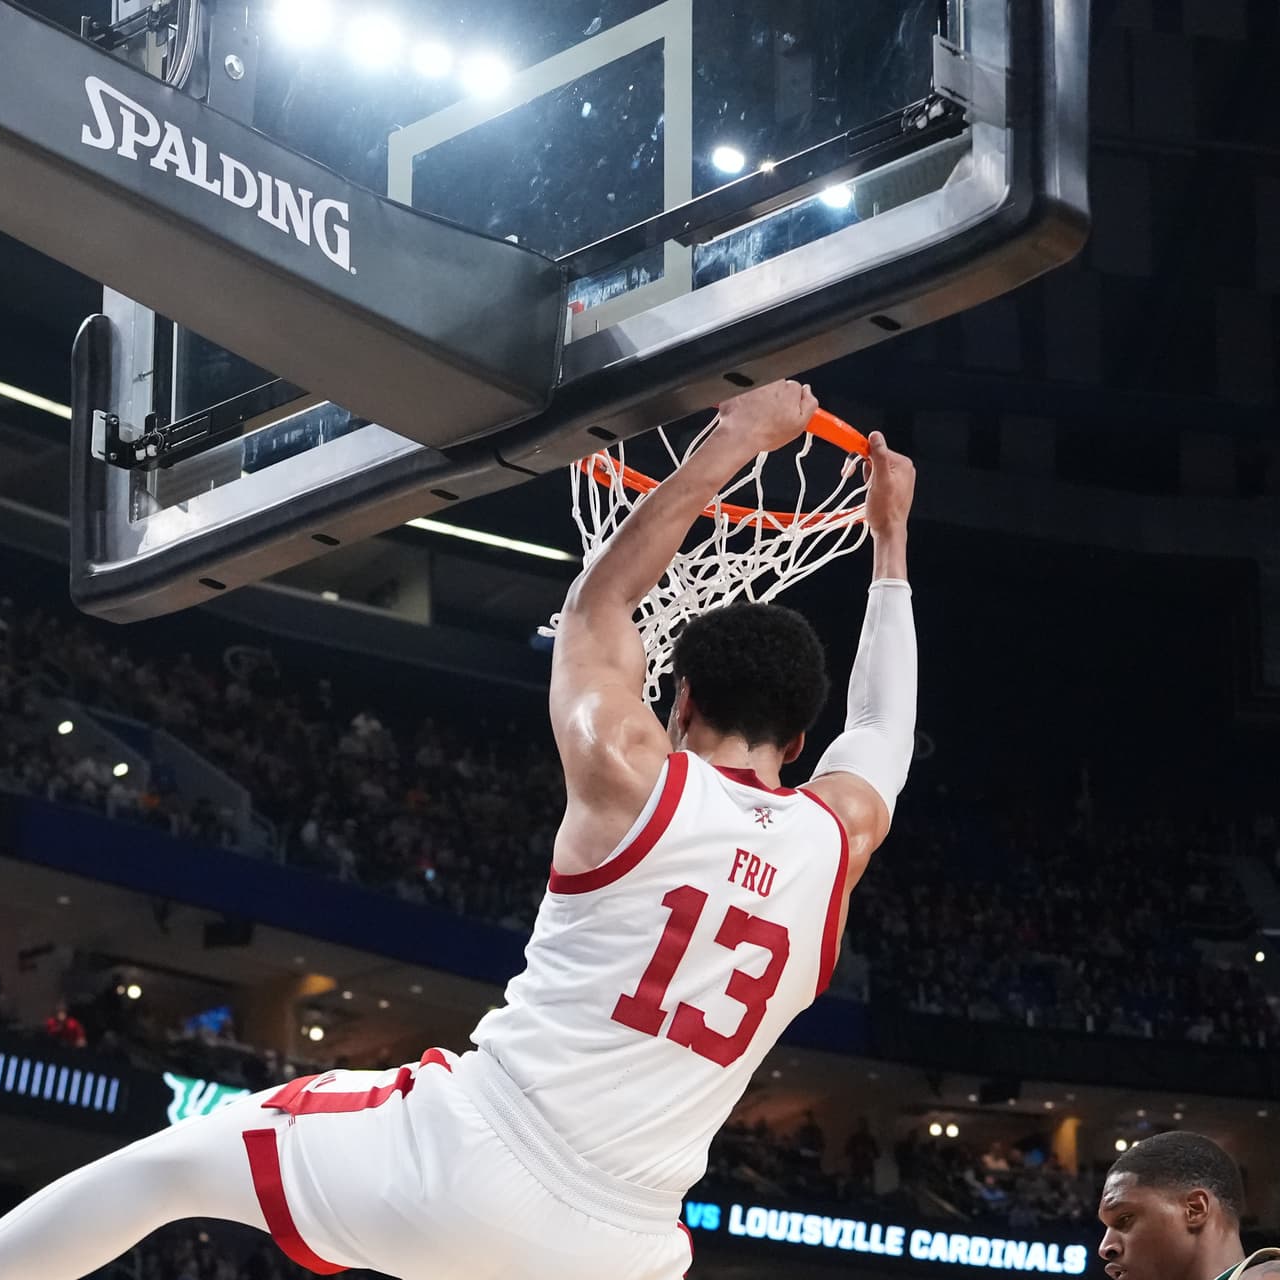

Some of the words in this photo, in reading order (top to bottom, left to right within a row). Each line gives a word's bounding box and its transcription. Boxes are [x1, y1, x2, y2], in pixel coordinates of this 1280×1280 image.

[80, 73, 352, 274] SPALDING
[727, 848, 778, 898] FRU
[611, 884, 790, 1068] 13
[686, 1200, 721, 1232] VS
[727, 1204, 906, 1257] LOUISVILLE
[909, 1229, 1087, 1276] CARDINALS
